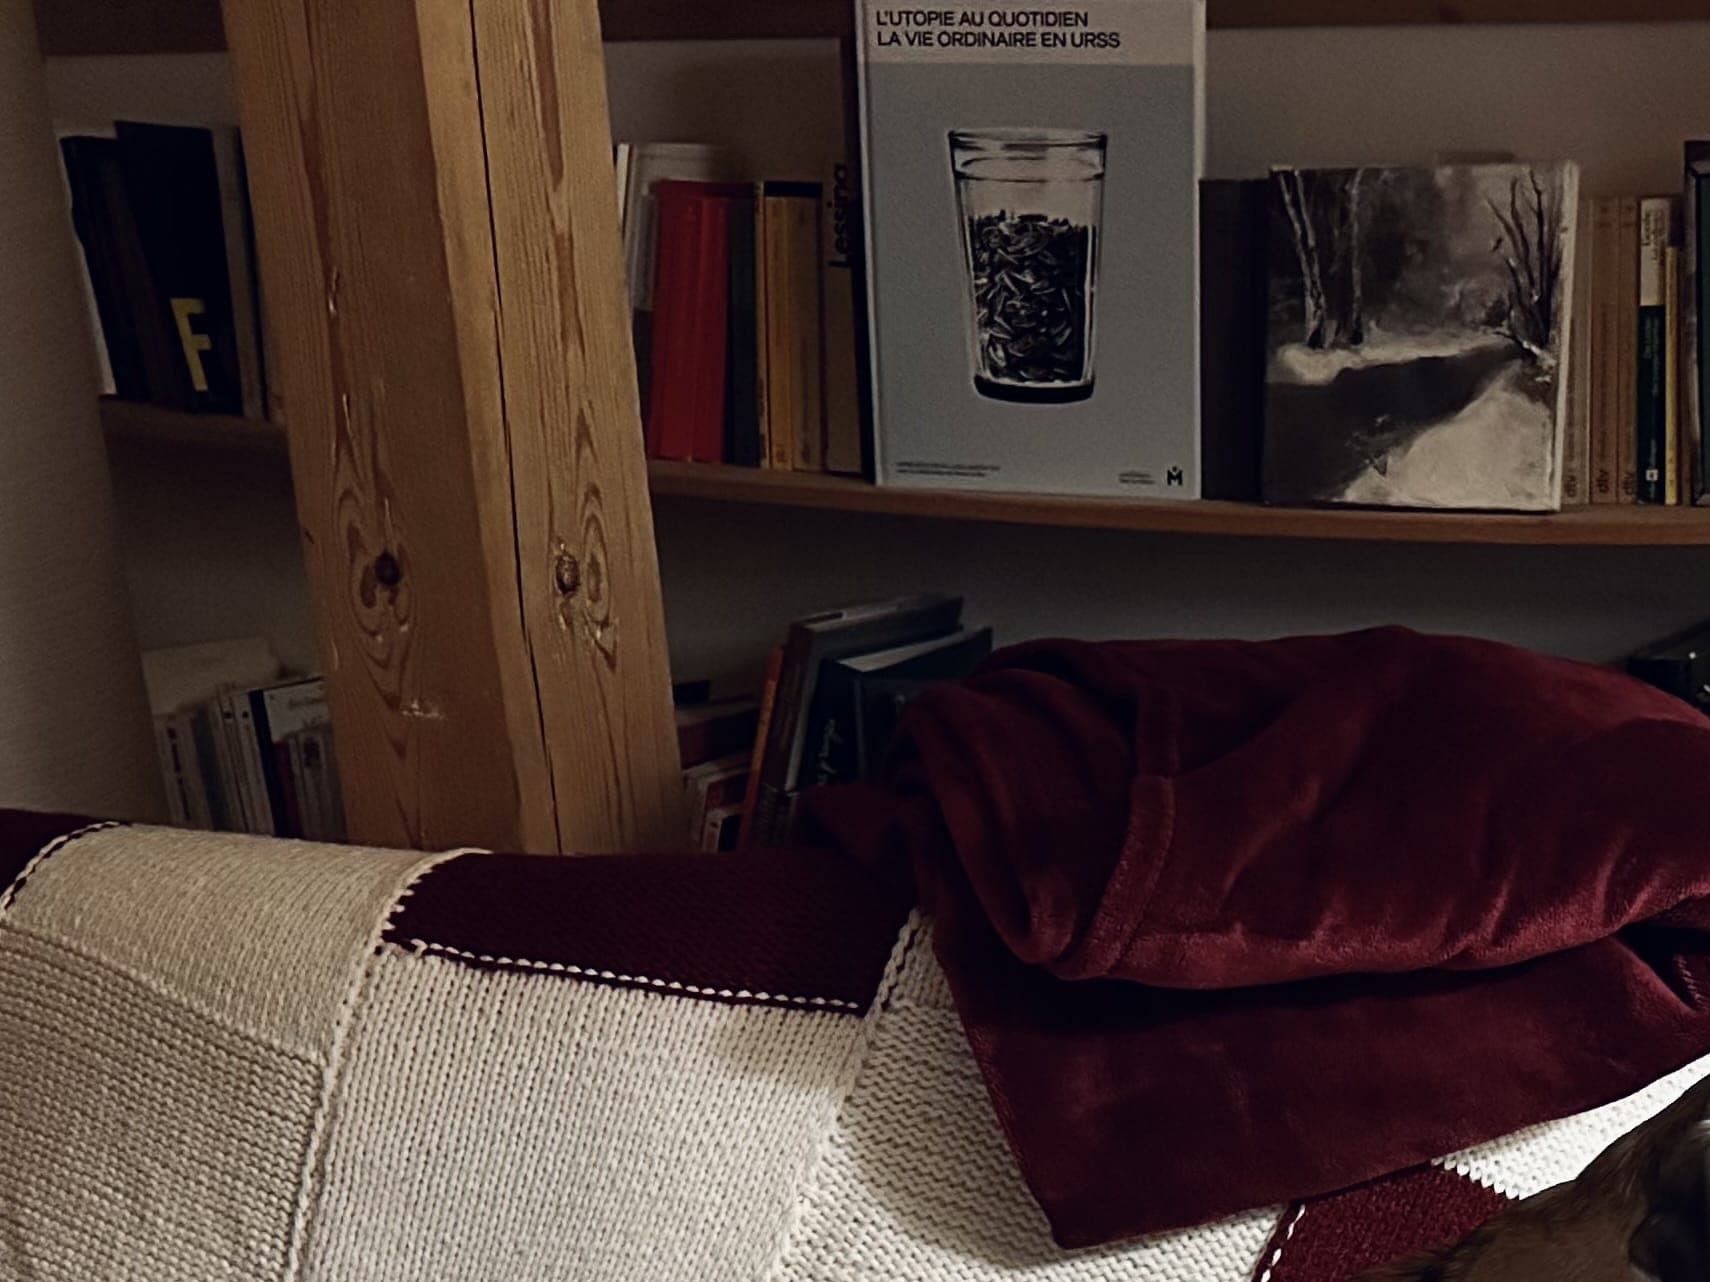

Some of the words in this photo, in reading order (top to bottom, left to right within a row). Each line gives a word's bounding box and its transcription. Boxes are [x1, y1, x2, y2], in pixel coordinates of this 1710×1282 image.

[876, 10, 955, 27] L'UTOPIE
[957, 10, 984, 27] AU
[988, 10, 1089, 27] QUOTIDIEN
[877, 31, 905, 48] LA
[905, 31, 934, 48] VIE
[937, 31, 1037, 48] ORDINAIRE
[1041, 31, 1067, 48] EN
[1070, 31, 1121, 48] URSS
[170, 297, 212, 392] F
[1596, 468, 1610, 493] dtv
